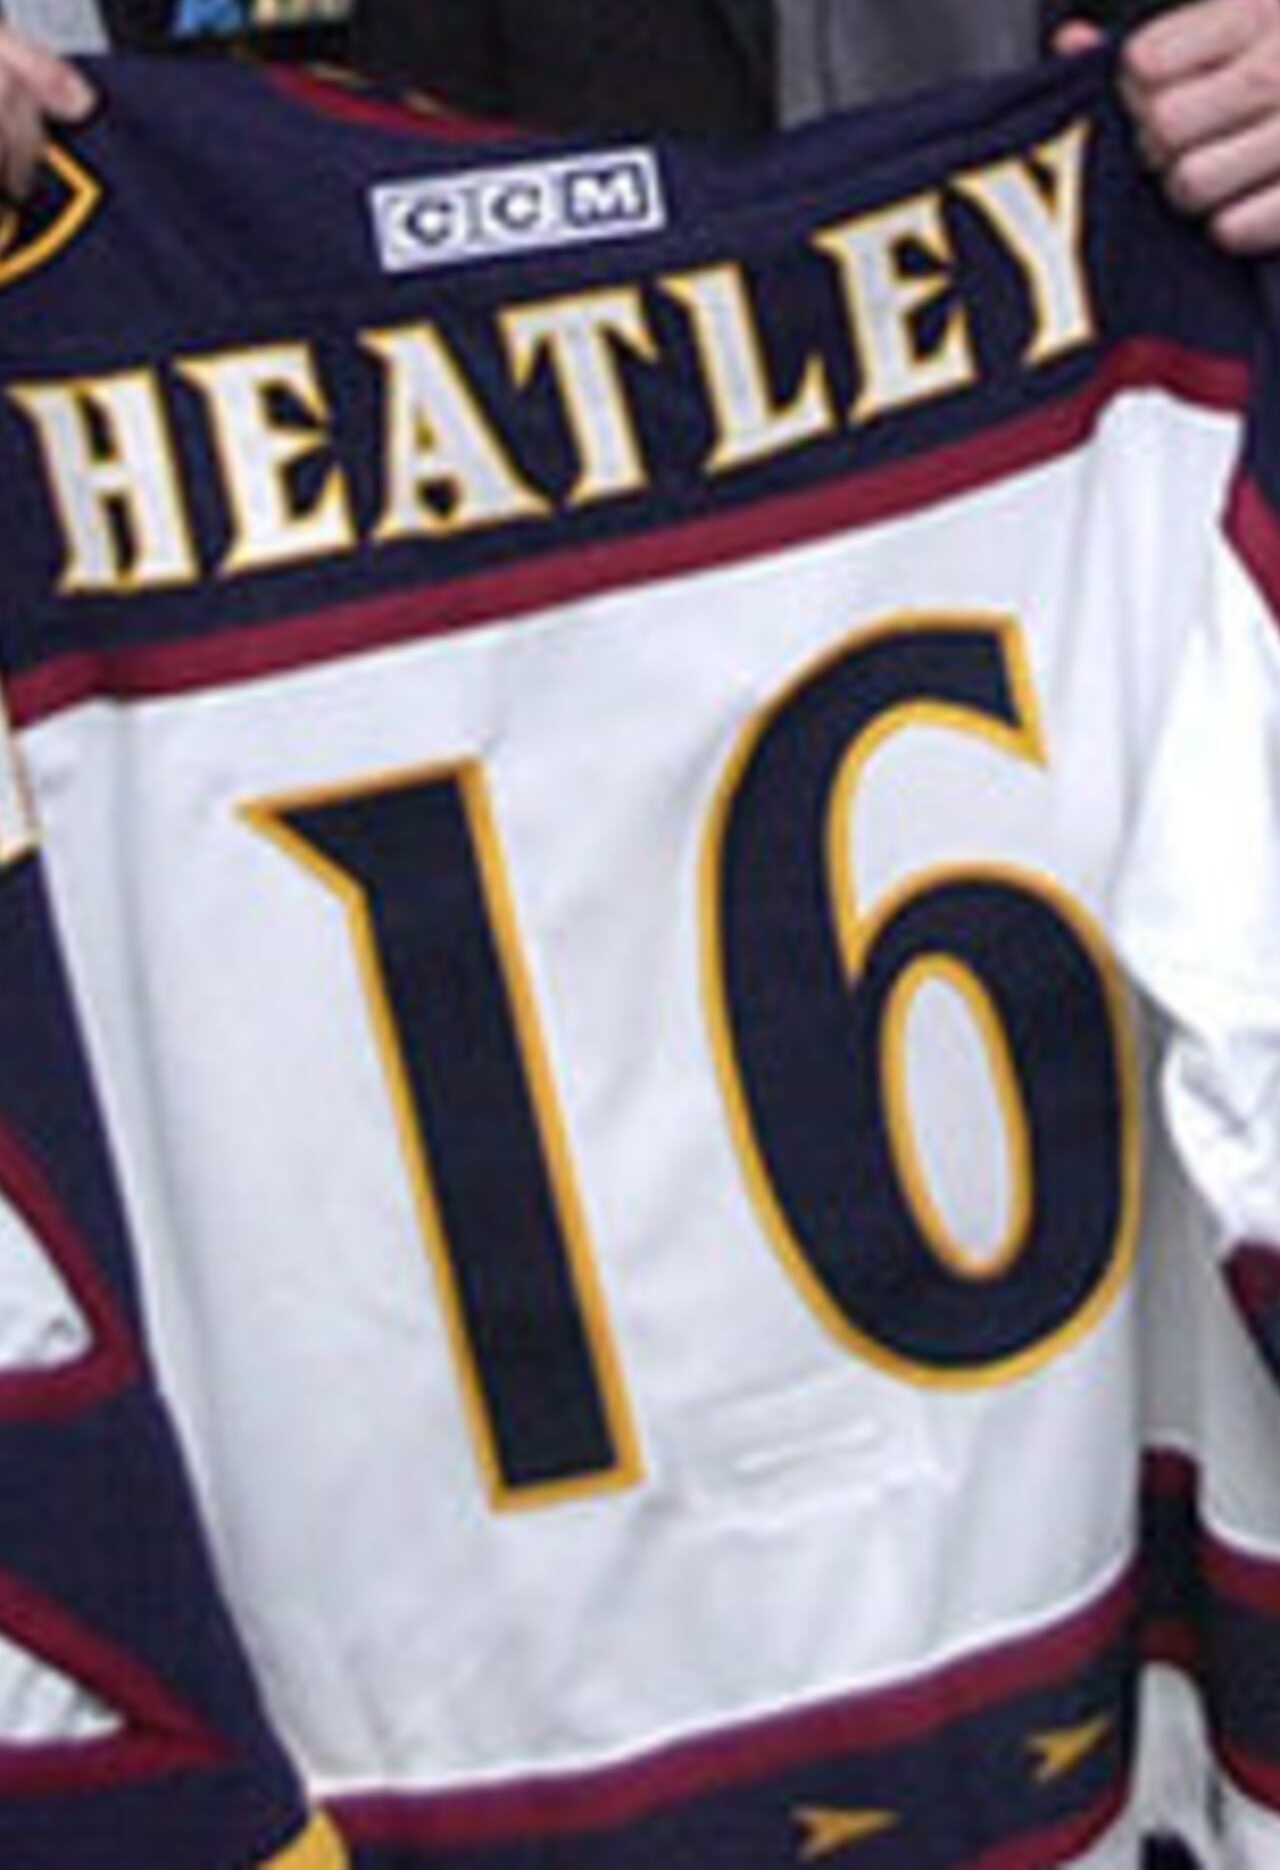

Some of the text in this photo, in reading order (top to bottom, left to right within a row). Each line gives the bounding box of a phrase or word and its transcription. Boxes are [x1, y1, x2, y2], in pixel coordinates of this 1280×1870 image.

[8, 120, 1099, 595] HEATLEY
[382, 155, 656, 256] CCM
[234, 606, 1146, 1516] 16
